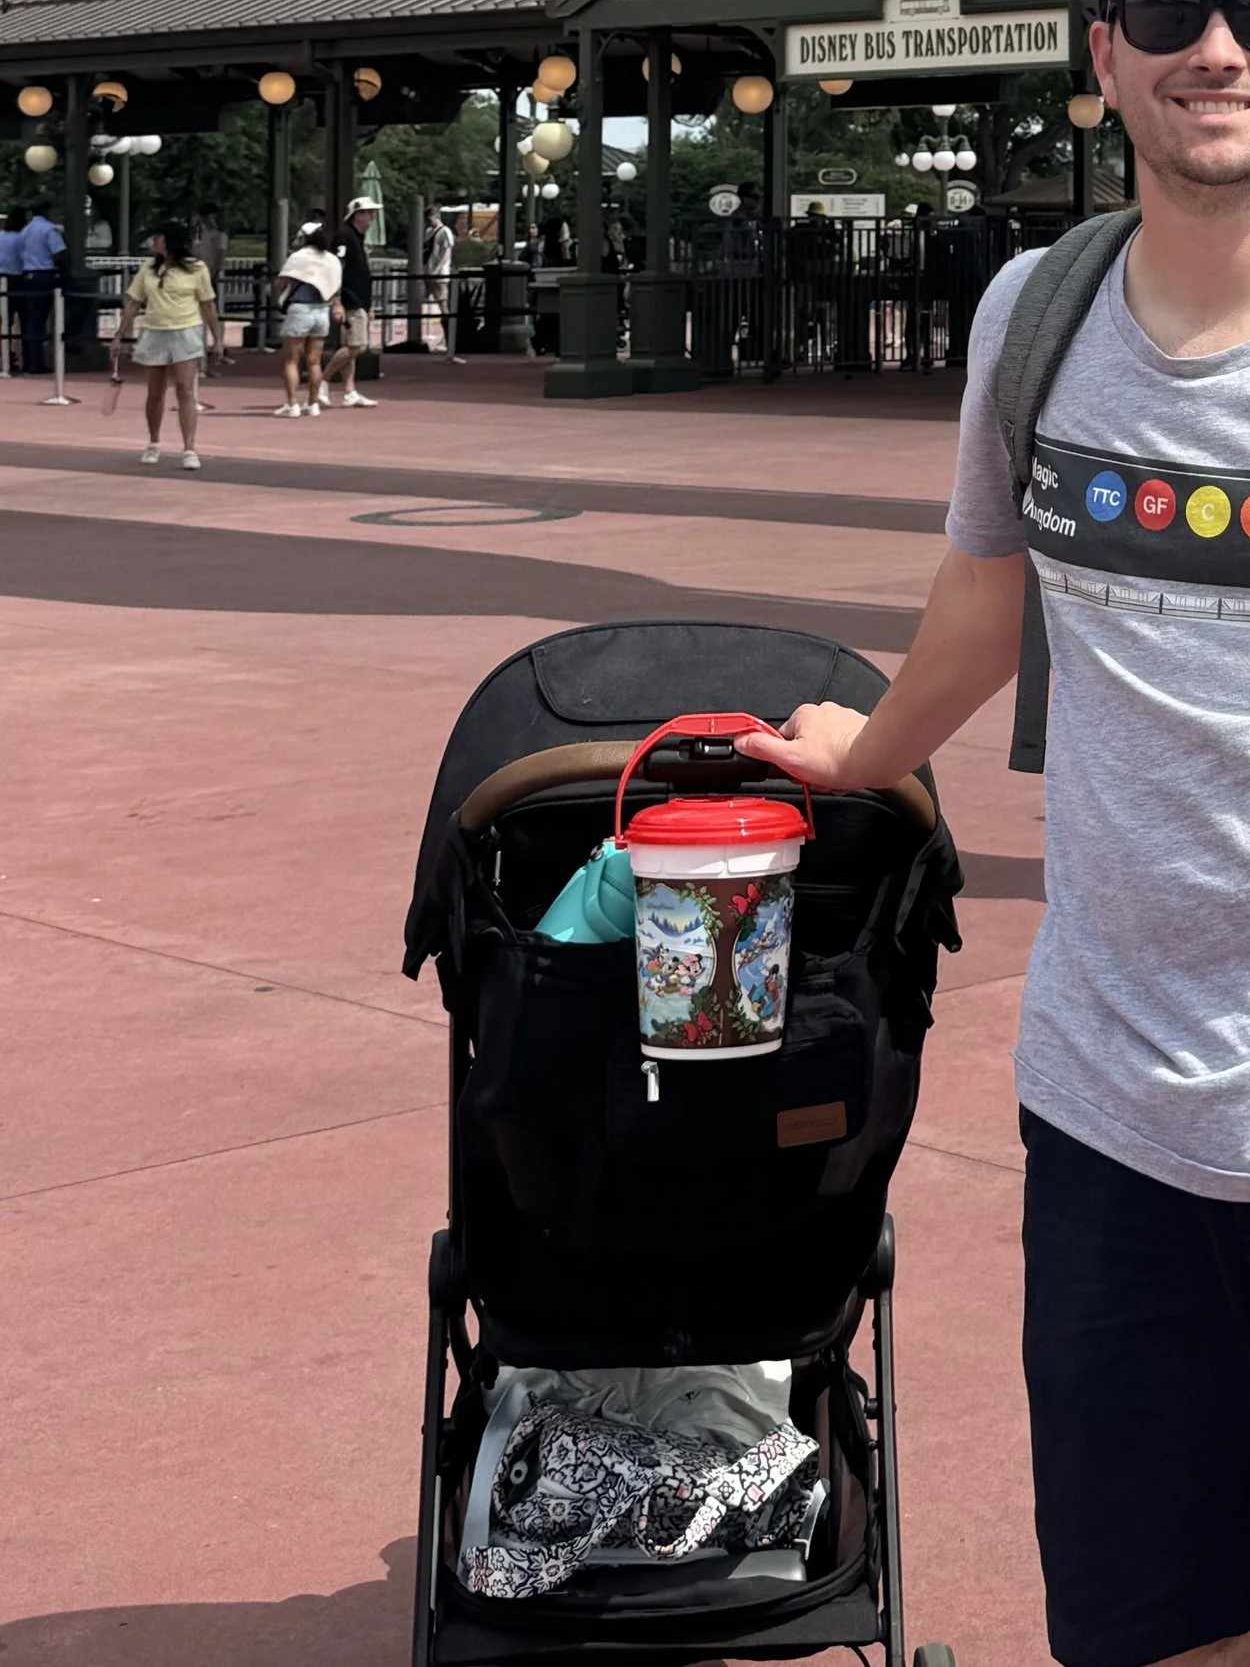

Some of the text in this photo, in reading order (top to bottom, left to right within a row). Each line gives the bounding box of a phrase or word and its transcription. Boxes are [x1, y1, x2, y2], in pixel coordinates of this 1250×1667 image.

[800, 20, 1059, 64] DISNEY BUS TRANSPORTATION
[1093, 486, 1121, 506] TTC
[1143, 495, 1169, 515] GF
[1201, 503, 1215, 521] C
